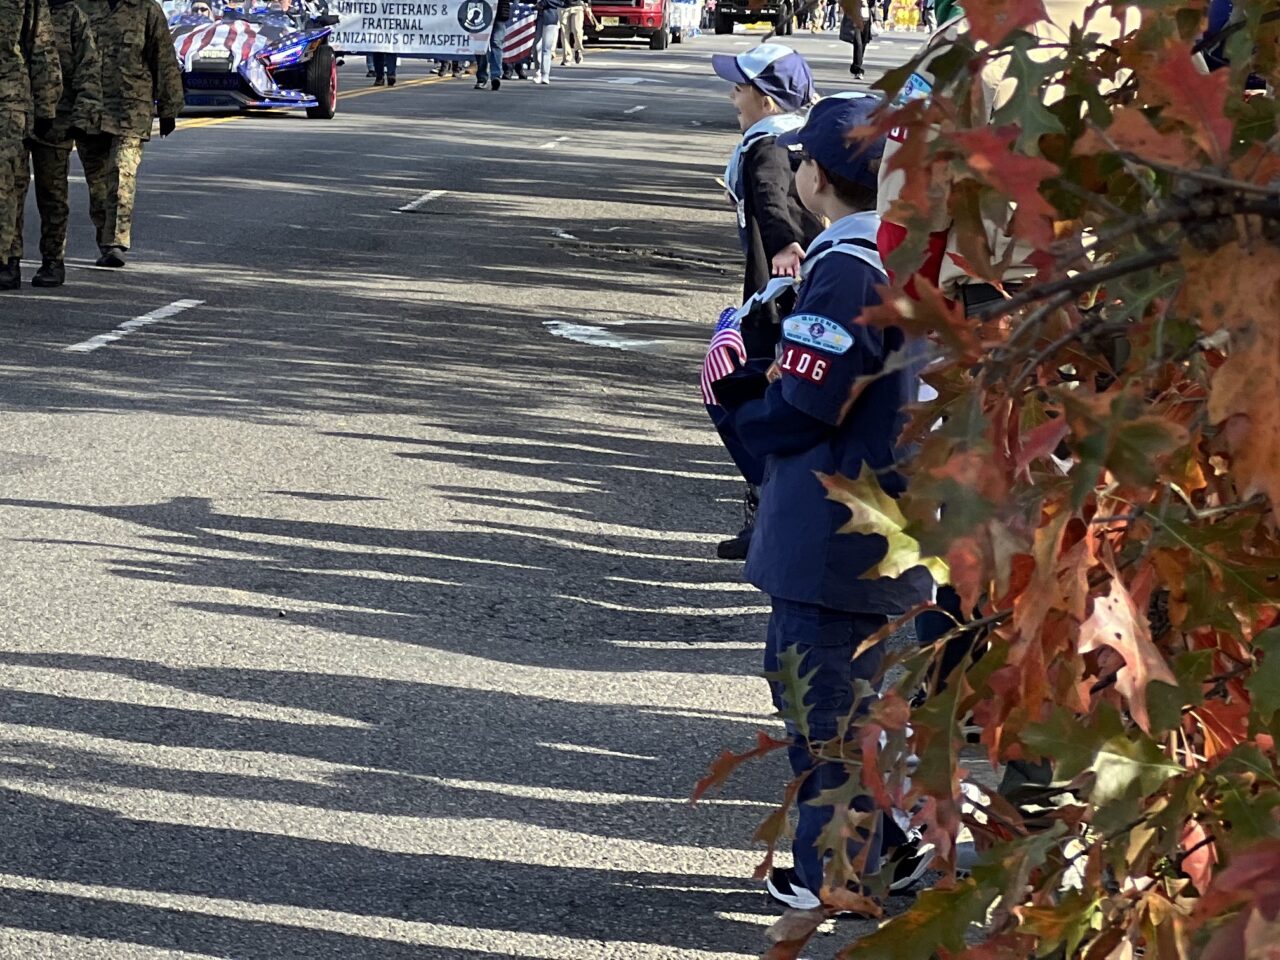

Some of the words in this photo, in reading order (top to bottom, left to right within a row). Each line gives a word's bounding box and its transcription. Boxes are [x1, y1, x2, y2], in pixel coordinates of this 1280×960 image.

[338, 1, 377, 15] UNITED
[381, 3, 438, 16] VETERANS
[441, 4, 448, 16] &
[361, 17, 424, 31] FRATERNAL
[329, 31, 399, 45] GANIZATIONS
[402, 33, 416, 45] OF
[419, 33, 470, 47] MASPETH
[782, 349, 827, 381] 106
